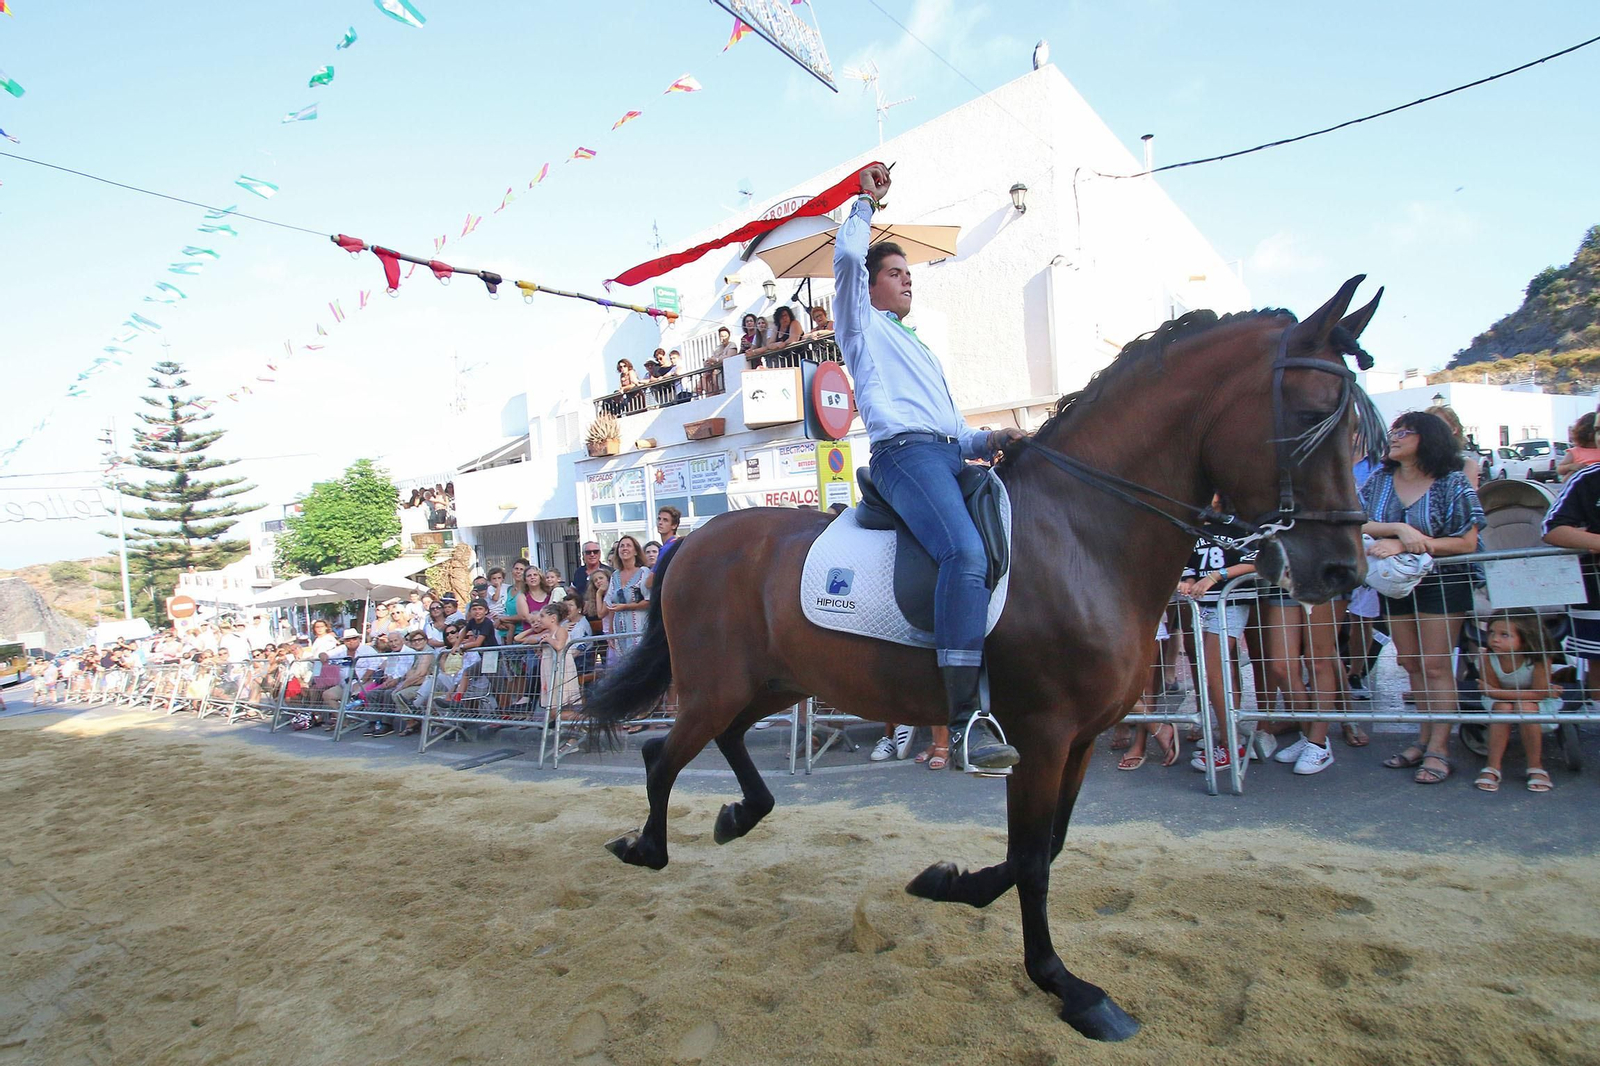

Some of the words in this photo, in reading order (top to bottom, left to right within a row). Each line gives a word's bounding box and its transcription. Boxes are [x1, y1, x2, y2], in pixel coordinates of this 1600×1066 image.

[779, 443, 816, 456] ELECTROMO
[588, 473, 613, 482] REGALOS
[766, 489, 818, 506] REGALOS
[1197, 546, 1226, 570] 78
[816, 597, 856, 610] HIPICUS
